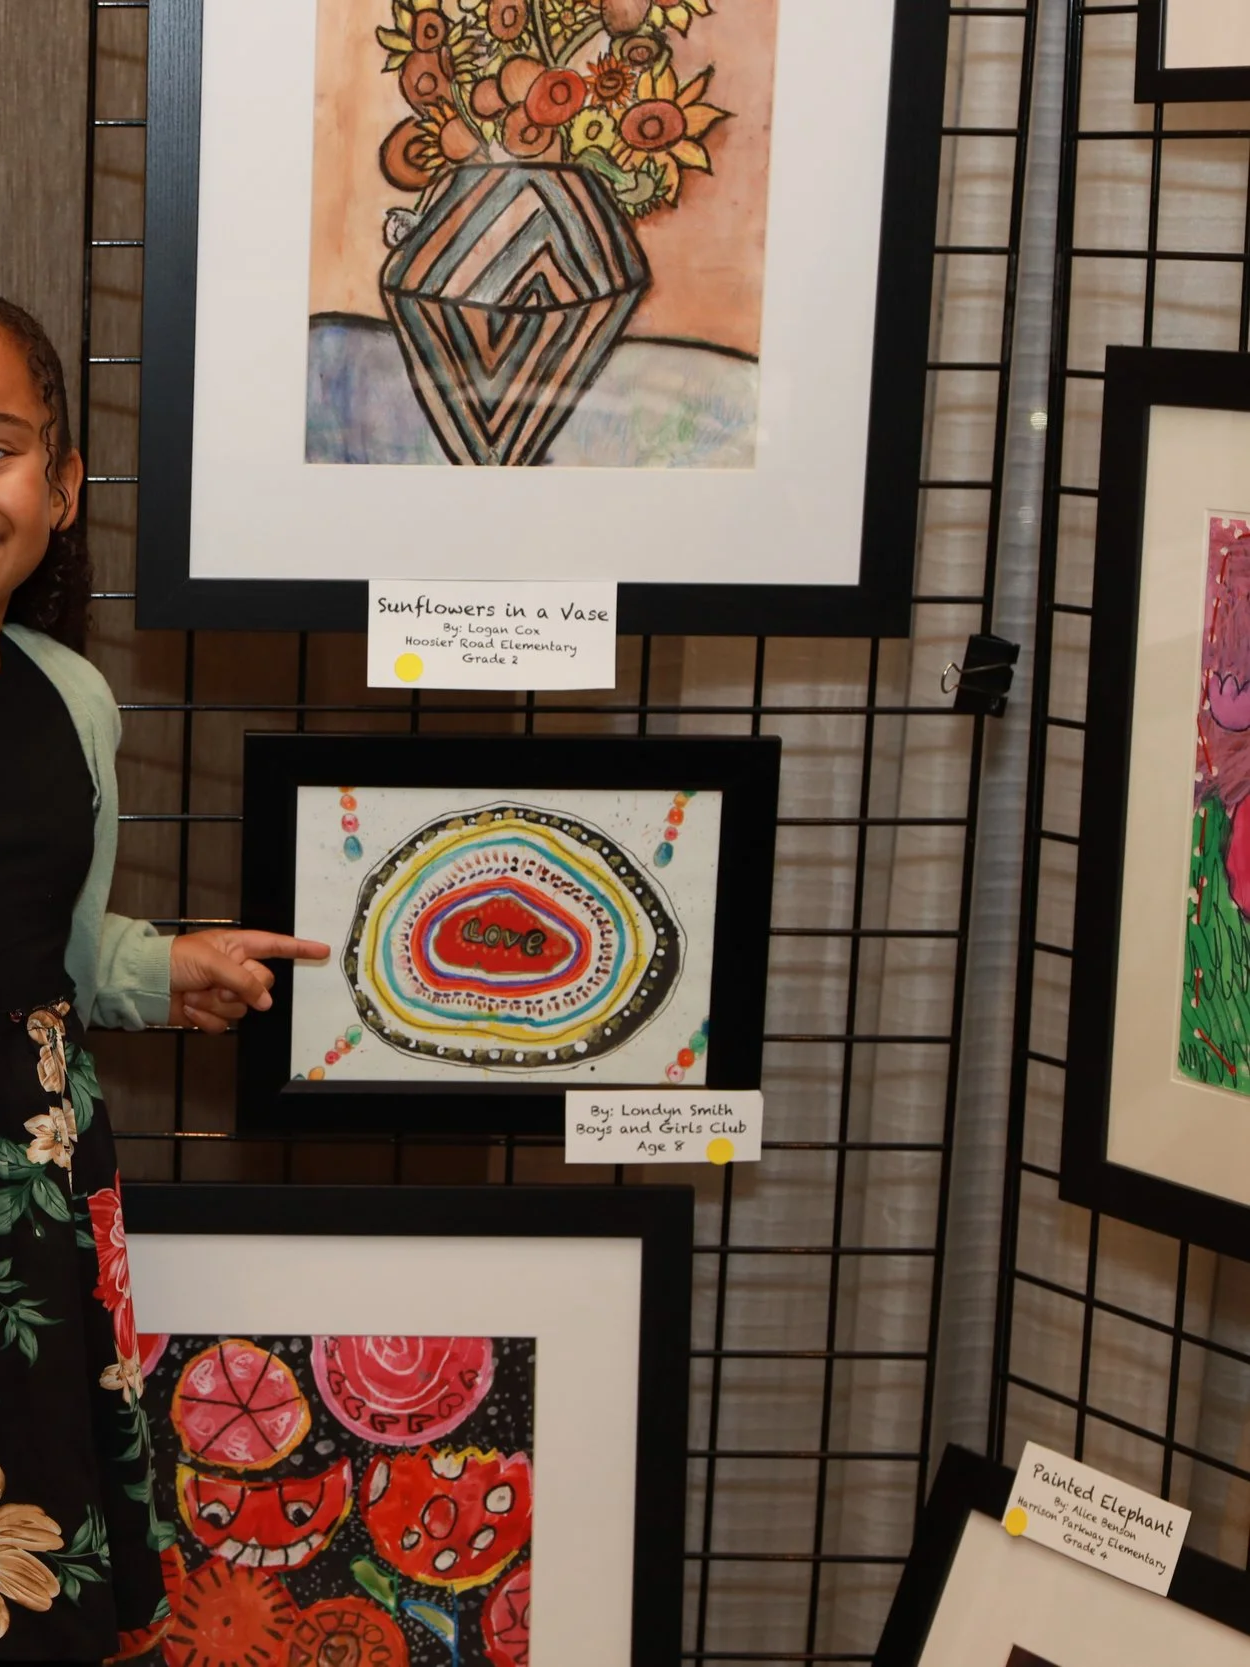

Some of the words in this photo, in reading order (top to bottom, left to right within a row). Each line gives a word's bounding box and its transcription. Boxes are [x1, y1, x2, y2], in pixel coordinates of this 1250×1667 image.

[378, 595, 495, 618] Sunflowers
[506, 603, 526, 618] in
[537, 609, 548, 619] a
[561, 603, 608, 622] Vase
[443, 623, 462, 638] By:
[469, 623, 508, 637] Logan
[515, 626, 540, 635] Cox
[406, 636, 454, 647] Hoosier
[460, 638, 494, 648] Road
[501, 640, 577, 657] Elementary
[462, 653, 506, 664] Grade
[512, 655, 518, 664] 2
[462, 918, 546, 956] Love
[591, 1106, 613, 1123] By:
[622, 1103, 681, 1123] Londyn
[690, 1104, 733, 1116] Smith
[576, 1124, 612, 1141] Boys
[620, 1122, 652, 1133] and
[659, 1121, 702, 1134] Girls
[710, 1120, 747, 1134] Club
[637, 1141, 666, 1155] Age
[675, 1140, 685, 1151] 8
[1033, 1463, 1095, 1503] Painted
[1101, 1494, 1173, 1538] Elephant
[1054, 1497, 1069, 1513] By:
[1072, 1506, 1097, 1523] Alice
[1102, 1518, 1136, 1540] Benson
[1018, 1496, 1058, 1521] Harrison
[1062, 1517, 1104, 1547] Parkway
[1108, 1537, 1166, 1575] Elementary
[1063, 1534, 1095, 1555] Grade
[1101, 1551, 1107, 1560] 4
